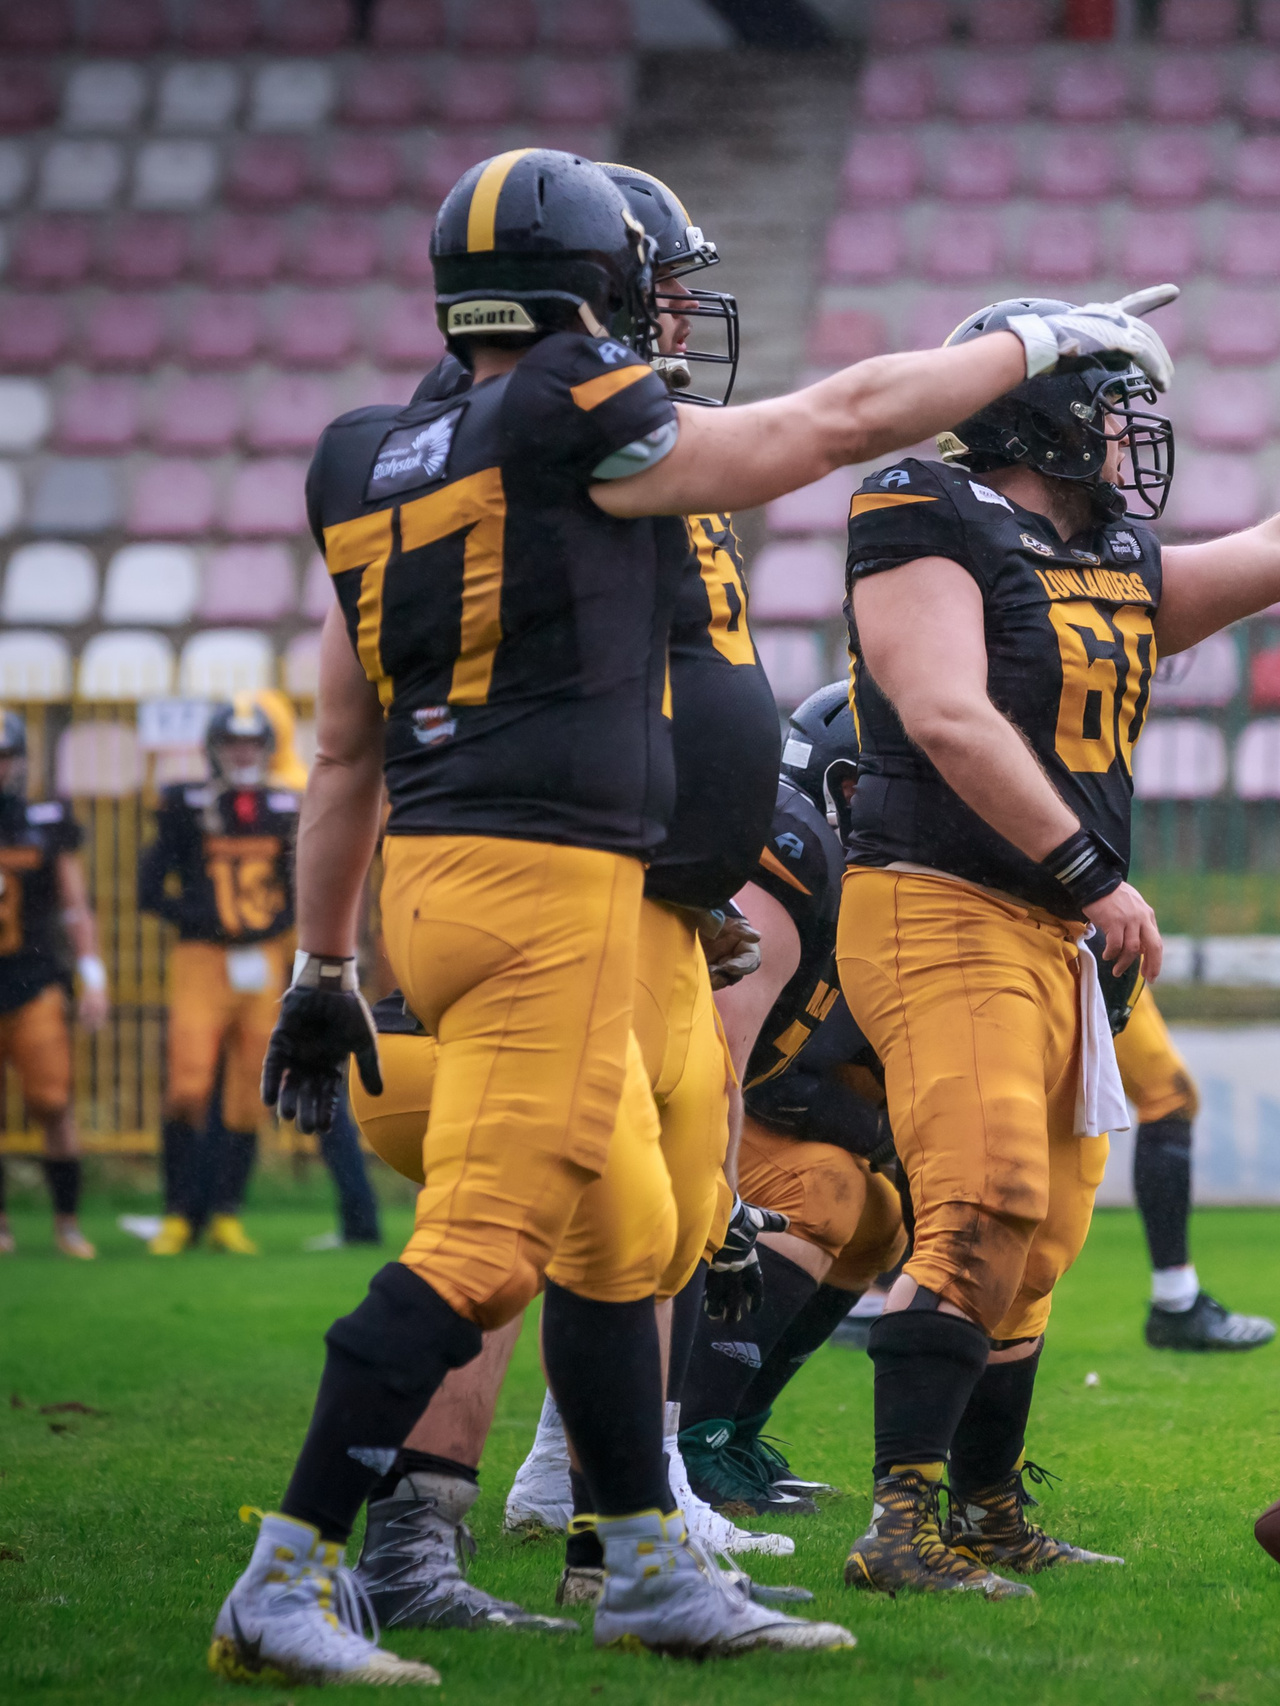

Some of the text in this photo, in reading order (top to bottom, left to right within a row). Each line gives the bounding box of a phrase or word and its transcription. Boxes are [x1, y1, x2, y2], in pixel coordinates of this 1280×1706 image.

[323, 466, 507, 722] 77
[1034, 568, 1152, 601] LOWLANDERS
[1047, 601, 1158, 777] 60
